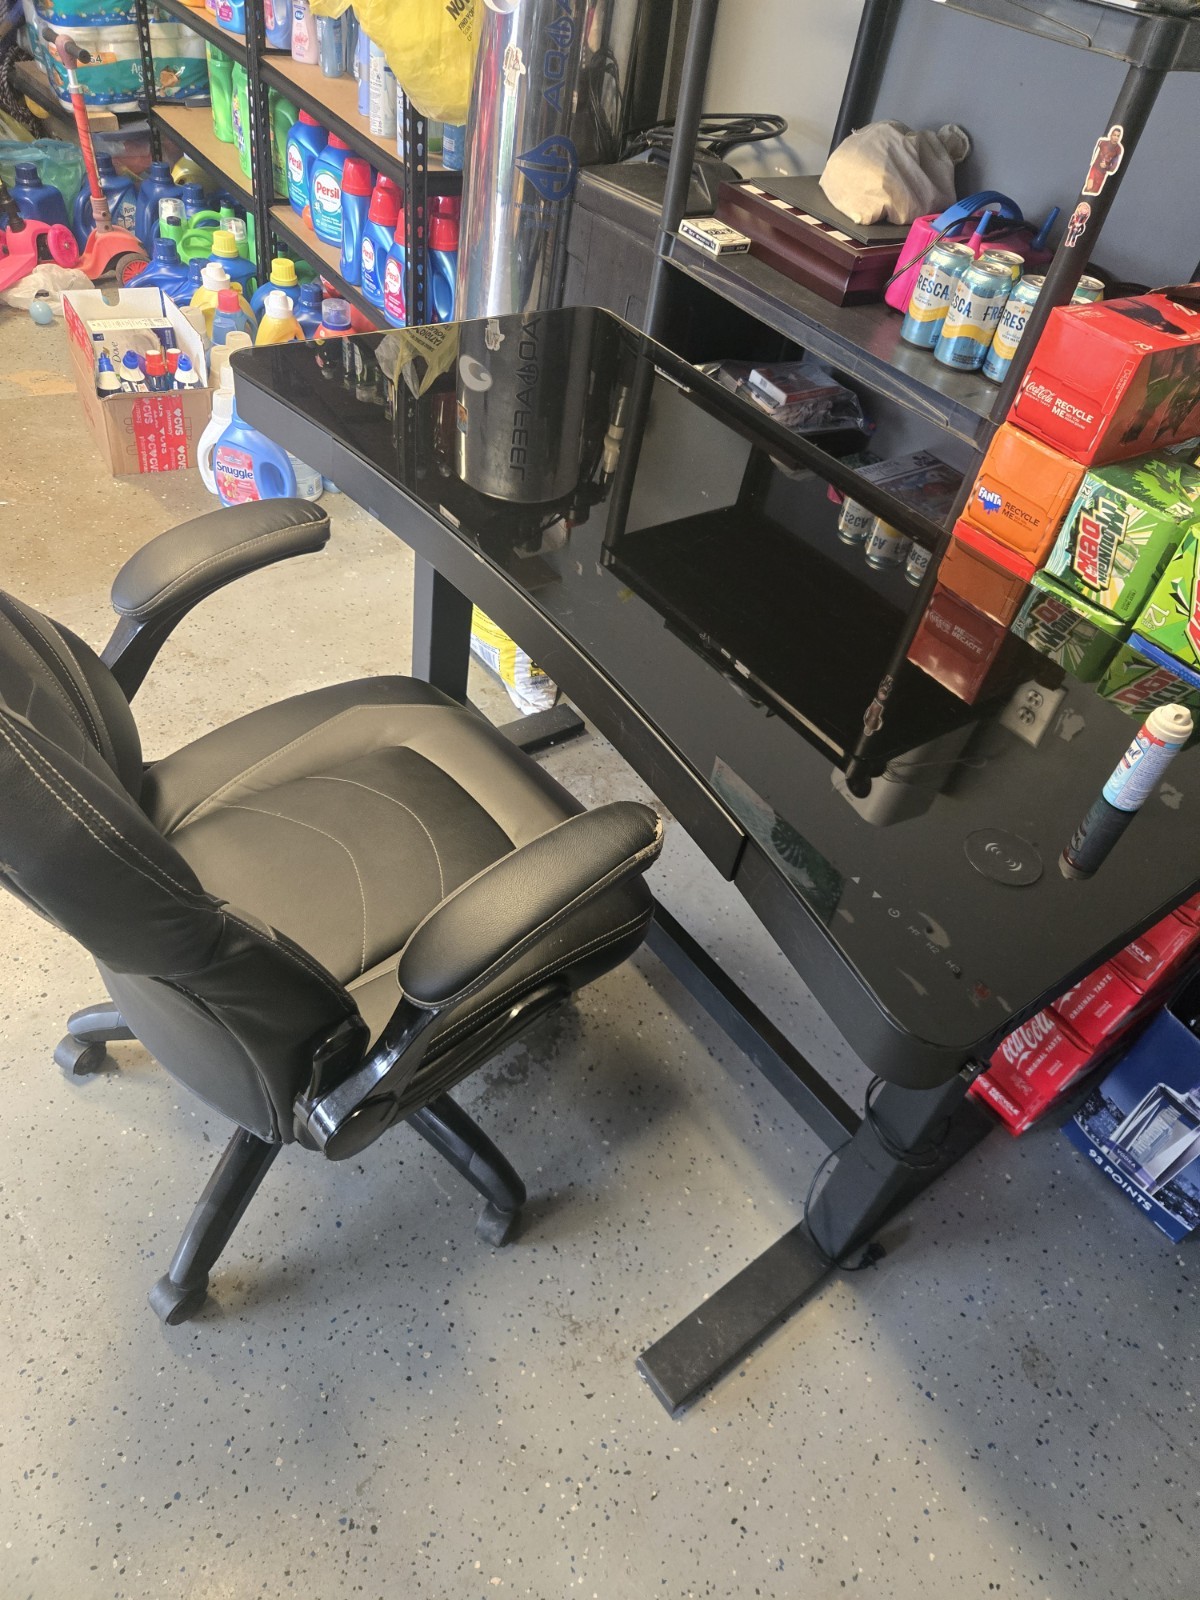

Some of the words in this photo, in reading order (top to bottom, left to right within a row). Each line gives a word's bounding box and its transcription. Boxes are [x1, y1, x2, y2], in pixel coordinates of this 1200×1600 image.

[316, 181, 340, 200] Persil
[143, 405, 153, 425] CVS
[1055, 398, 1094, 424] RECYCLE
[174, 417, 184, 436] CVS
[216, 461, 254, 480] Snuggle
[979, 486, 1002, 506] FANTA
[1005, 501, 1041, 528] RECYCLE
[1142, 602, 1170, 630] 12
[1069, 993, 1095, 1020] ORIGINAL
[1093, 974, 1112, 993] TASTE
[1025, 1052, 1048, 1076] ORIGINAL
[1045, 1035, 1062, 1053] TASTE
[1088, 1148, 1103, 1165] 93
[1103, 1165, 1152, 1211] POINTS
